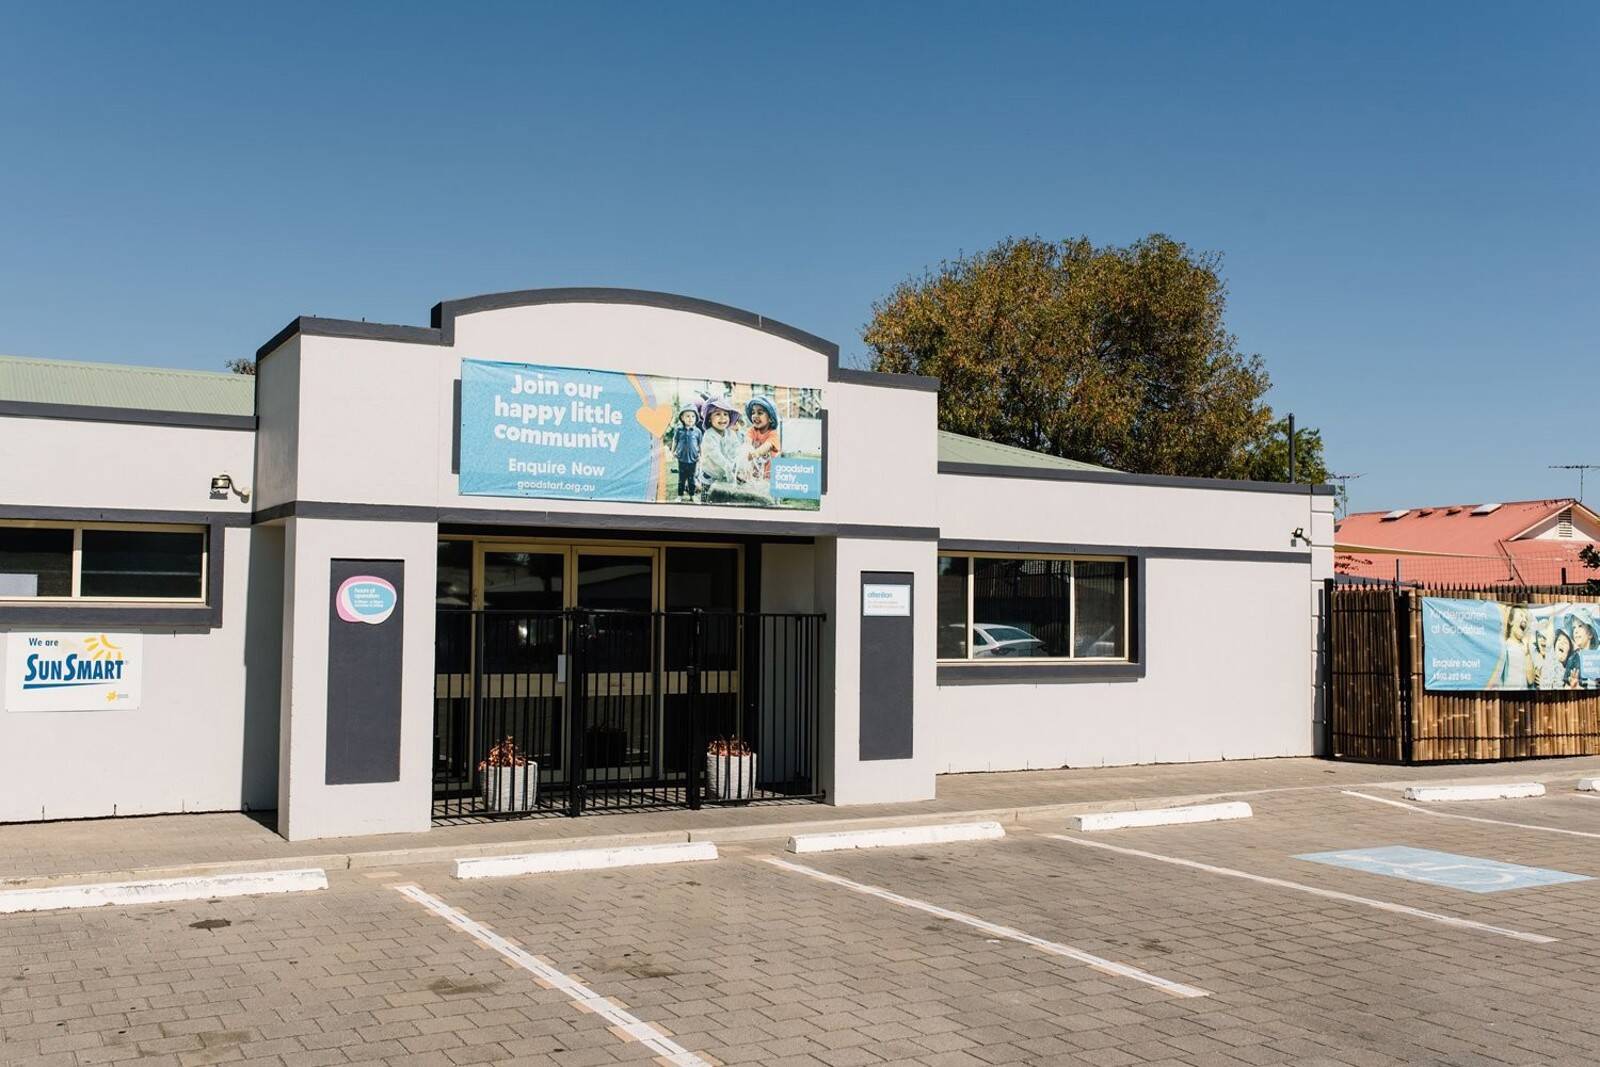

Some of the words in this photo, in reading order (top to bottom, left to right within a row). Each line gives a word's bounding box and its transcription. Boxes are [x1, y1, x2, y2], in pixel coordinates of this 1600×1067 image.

[511, 374, 560, 396] Join
[563, 382, 603, 399] our
[494, 395, 567, 426] happy
[571, 400, 624, 425] little
[494, 424, 620, 453] community
[508, 458, 567, 476] Enquire
[571, 461, 606, 477] Now
[775, 464, 815, 474] goodstart
[775, 473, 797, 483] early
[517, 479, 596, 493] goodstart.org.au
[775, 481, 809, 494] learning
[28, 637, 43, 647] We
[45, 639, 59, 647] are
